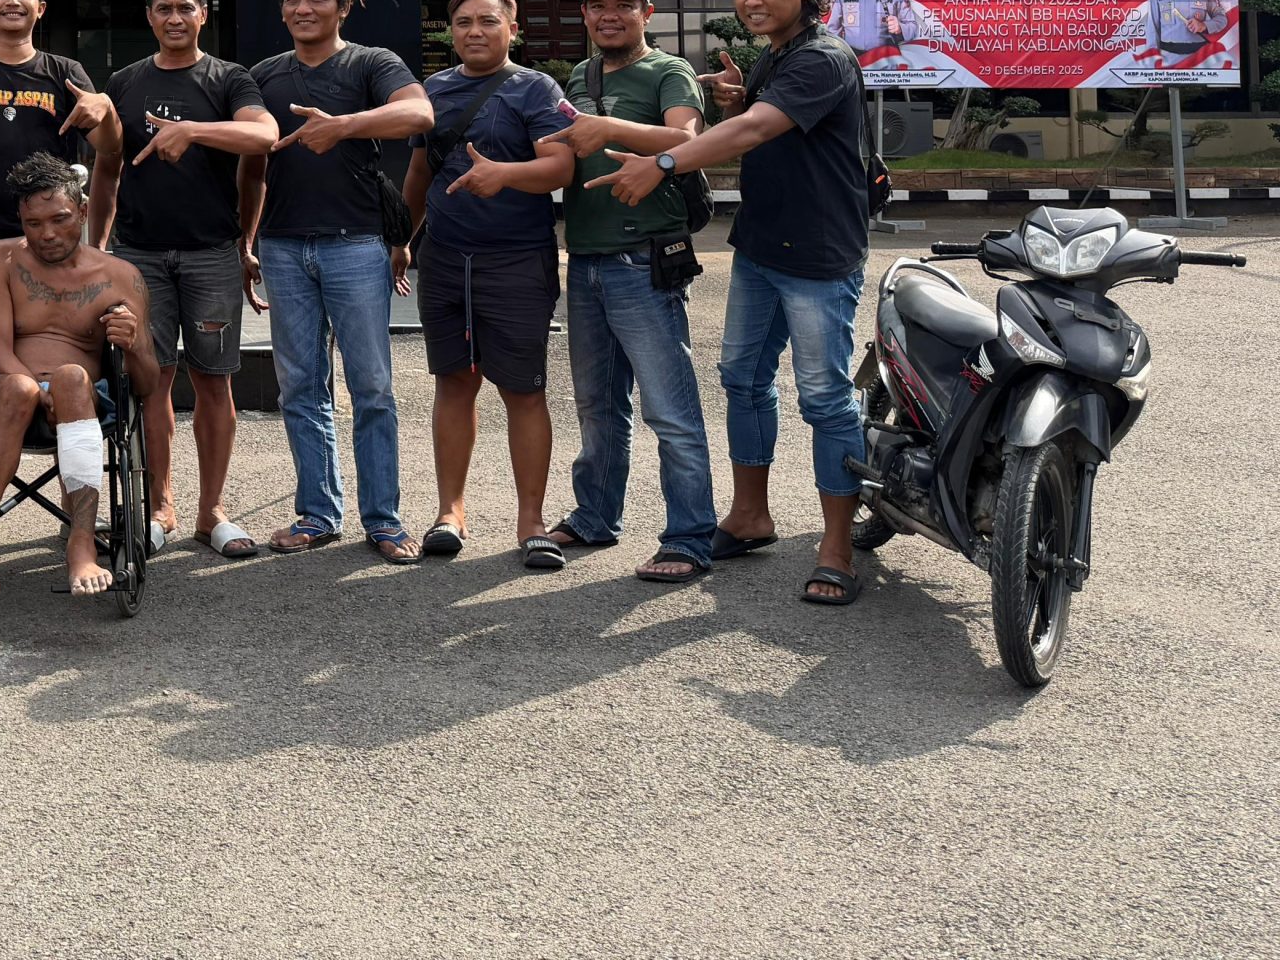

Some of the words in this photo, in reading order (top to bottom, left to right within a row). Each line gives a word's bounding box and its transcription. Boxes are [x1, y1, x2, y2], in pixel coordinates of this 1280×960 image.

[923, 8, 1028, 21] PEMUSNAHAN
[1032, 8, 1053, 21] BB
[1056, 8, 1098, 21] HASIL
[1102, 8, 1141, 22] KRYD
[422, 20, 448, 29] RASETYA
[918, 24, 1009, 37] MENJELANG
[1013, 24, 1063, 37] TAHUN
[1067, 24, 1108, 37] BARU
[1111, 24, 1146, 37] 2026
[928, 39, 943, 53] DI
[946, 39, 1013, 52] WILAYAH
[1017, 39, 1136, 52] KAB.LAMONGAN
[979, 66, 992, 75] 29
[995, 66, 1055, 75] DESEMBER
[1058, 66, 1084, 75] 2025
[970, 362, 994, 383] HONDA
